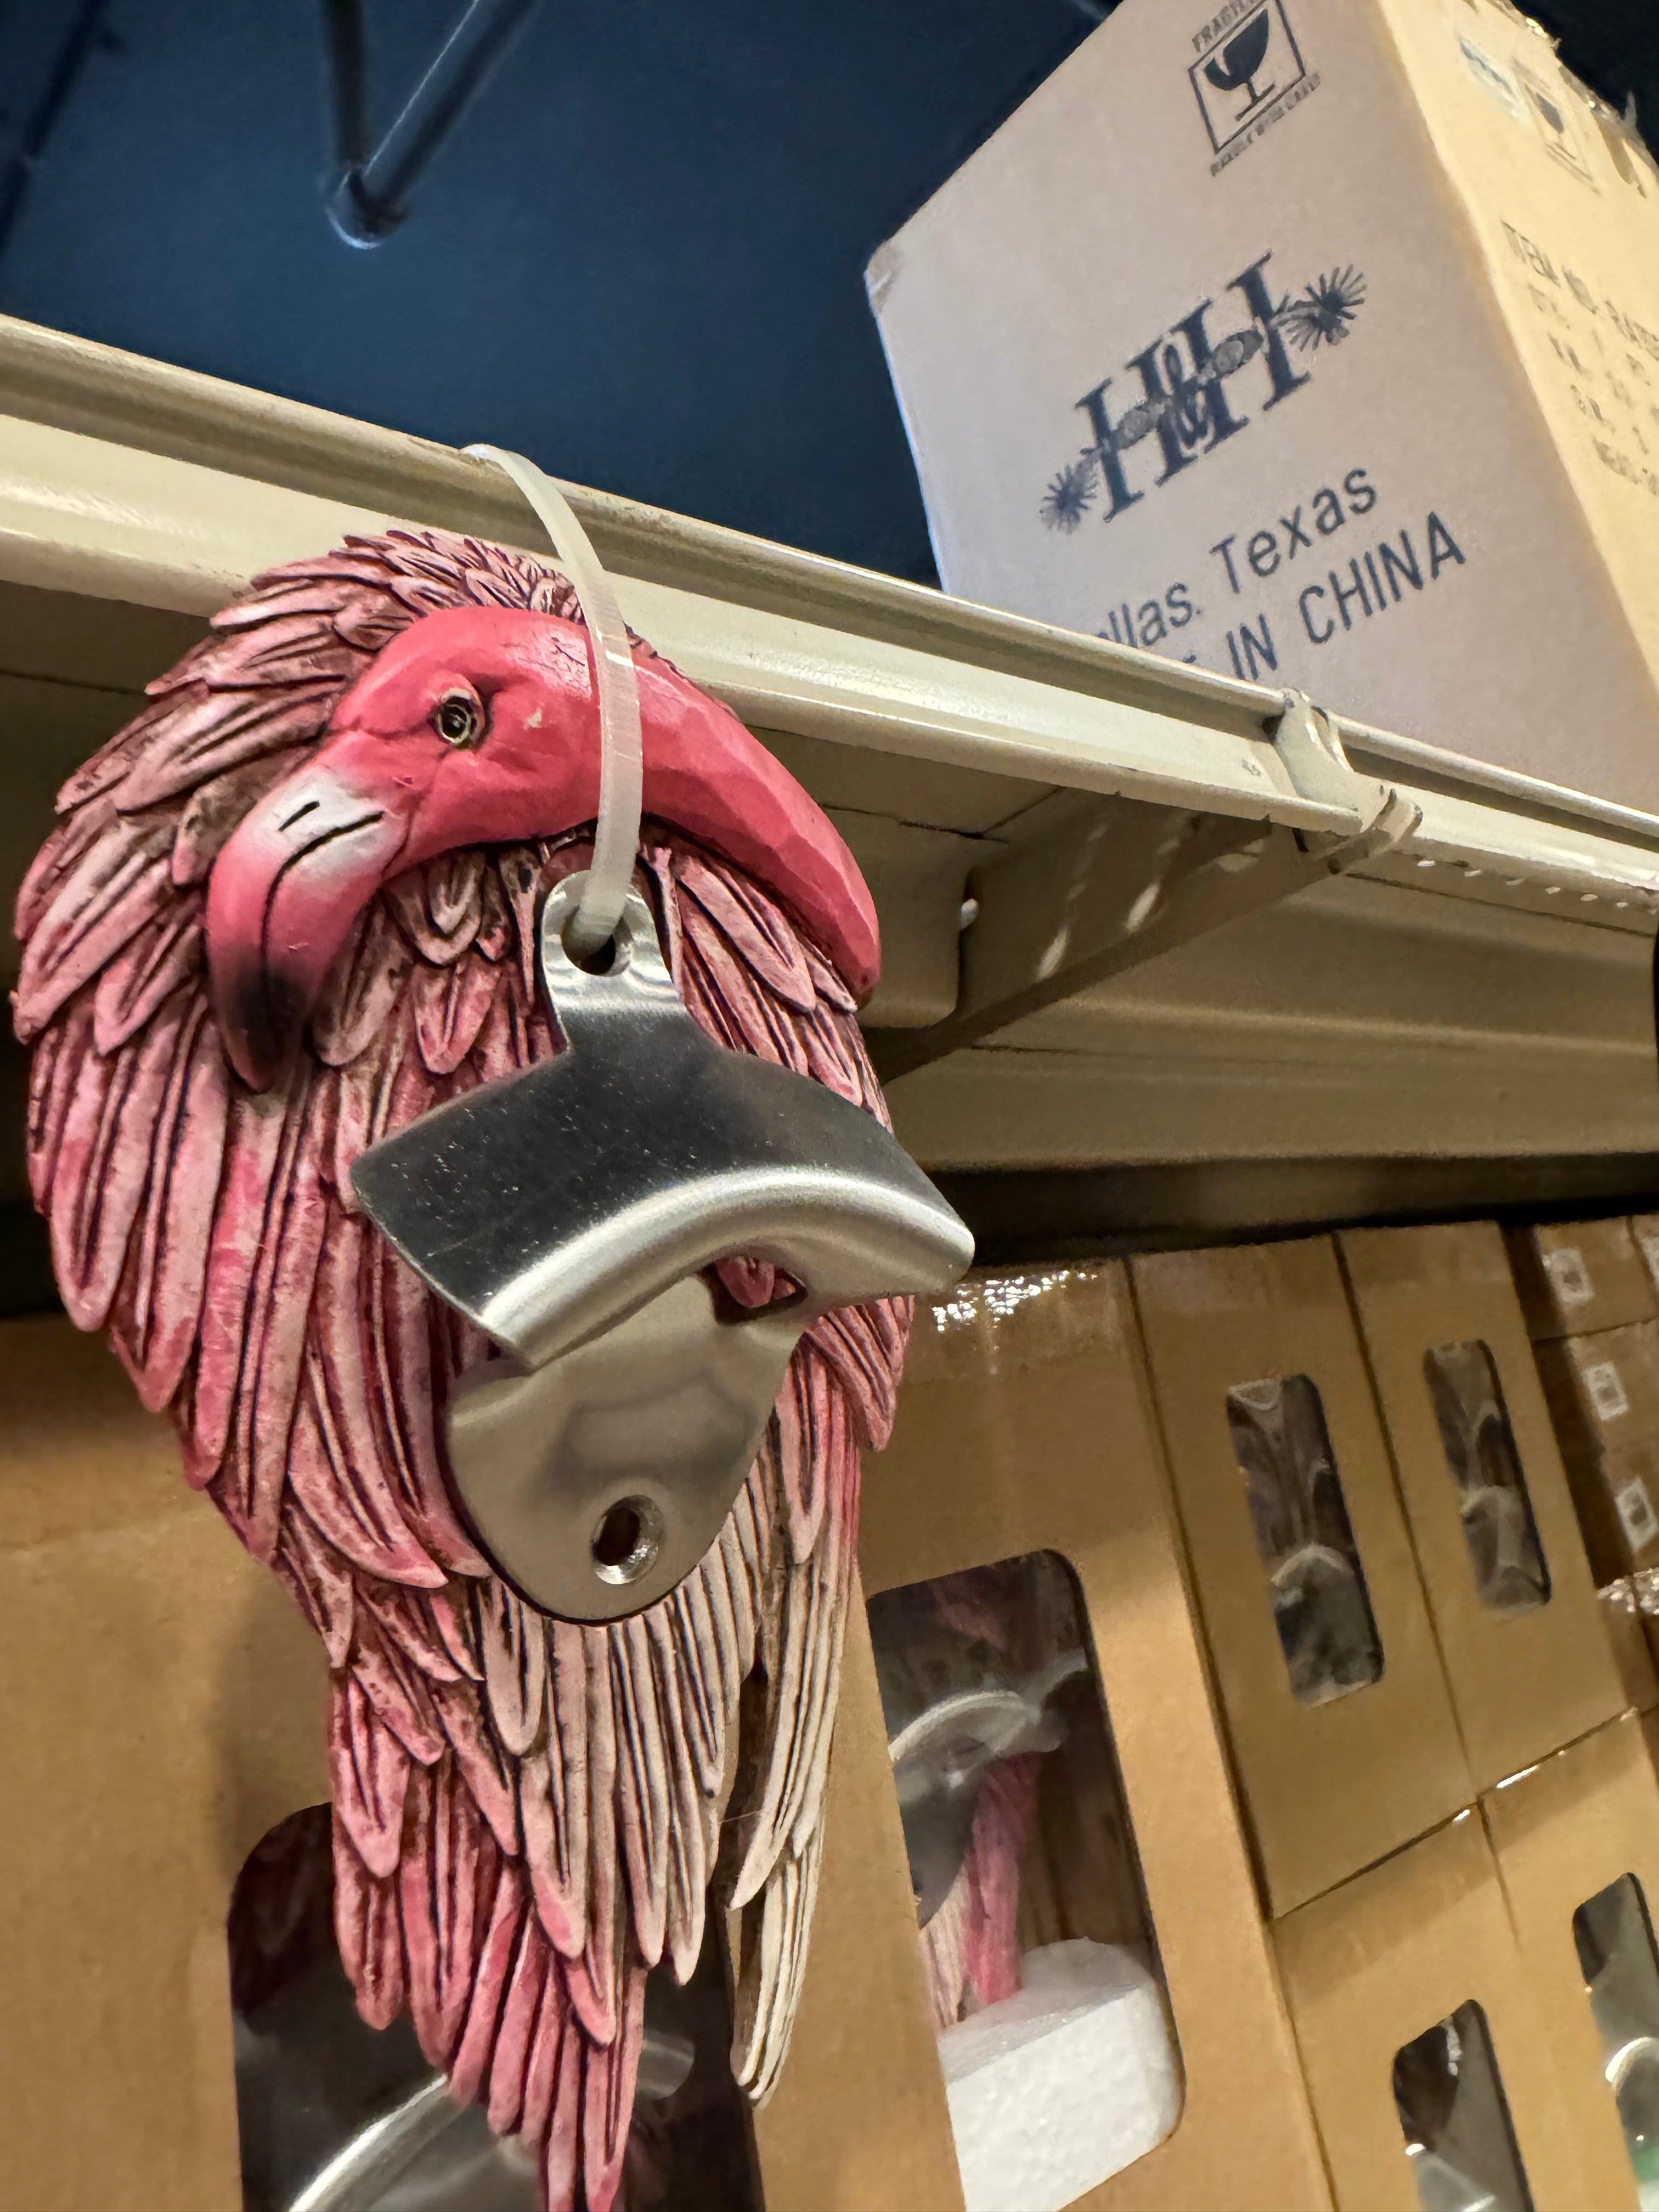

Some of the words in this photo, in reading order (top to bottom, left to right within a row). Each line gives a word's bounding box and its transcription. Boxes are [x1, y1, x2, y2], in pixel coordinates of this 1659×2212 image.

[1209, 469, 1376, 594] Texas
[1226, 613, 1278, 681] IN
[1299, 510, 1466, 644] CHINA
